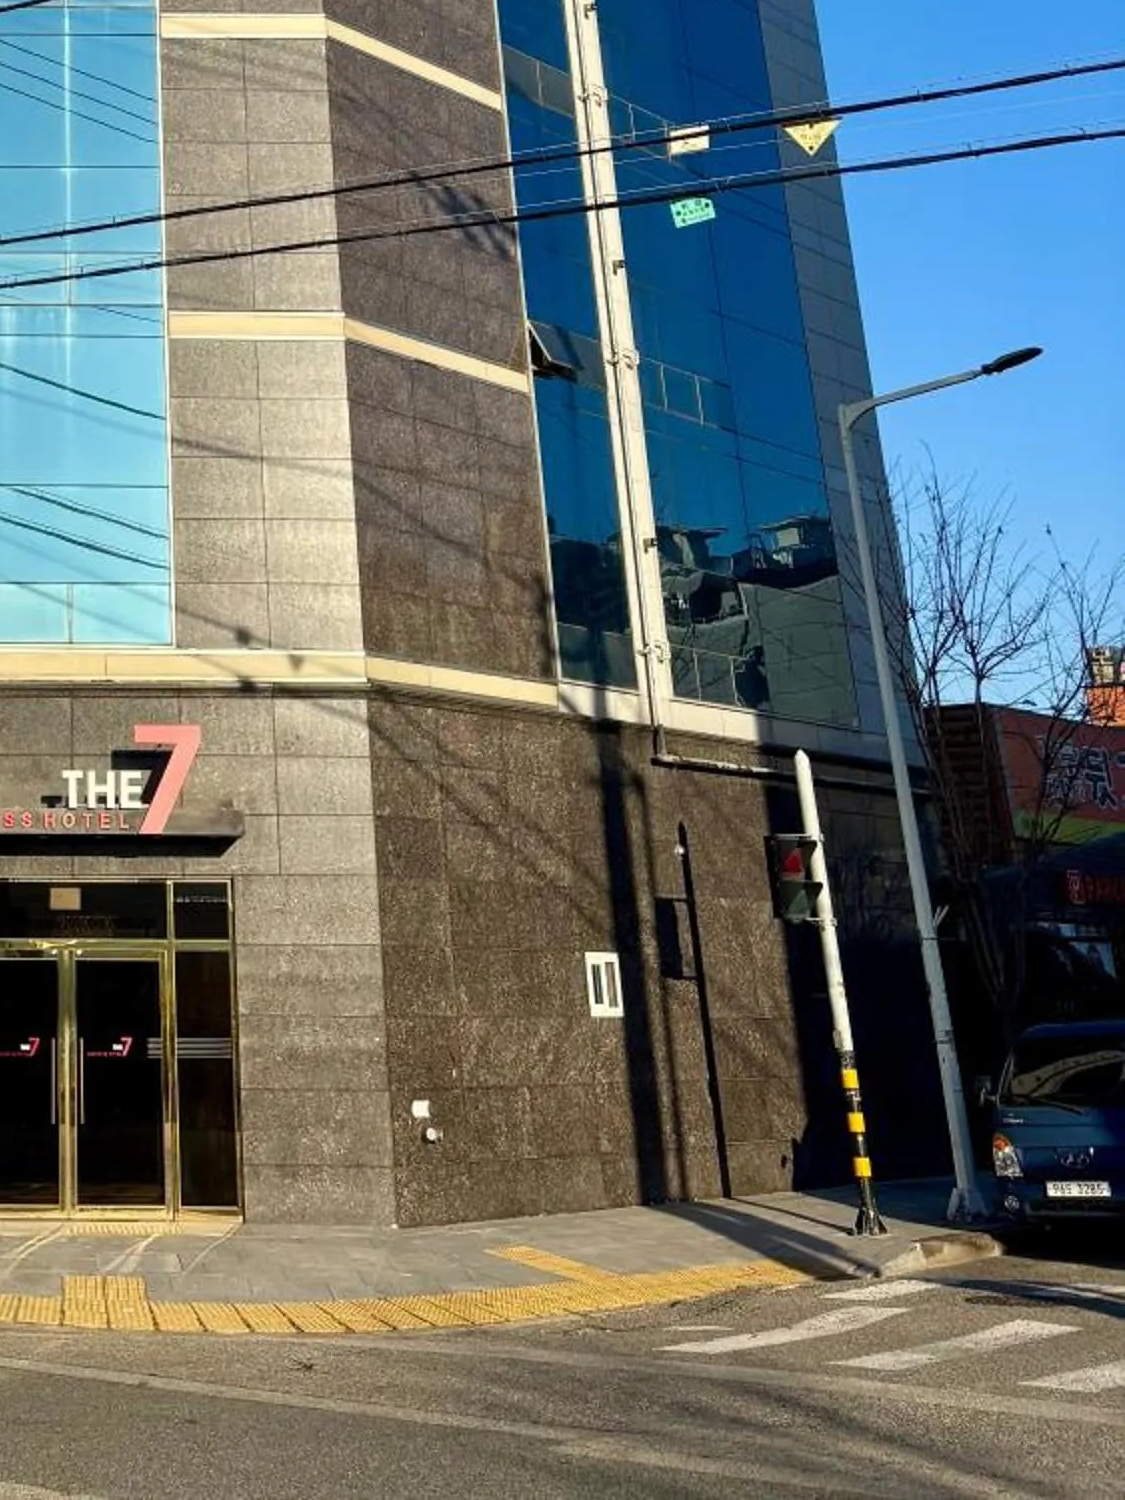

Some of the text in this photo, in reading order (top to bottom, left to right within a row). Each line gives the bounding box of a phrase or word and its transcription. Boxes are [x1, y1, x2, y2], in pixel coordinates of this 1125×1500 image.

[62, 724, 202, 835] THE 7
[42, 811, 130, 830] HOTEL
